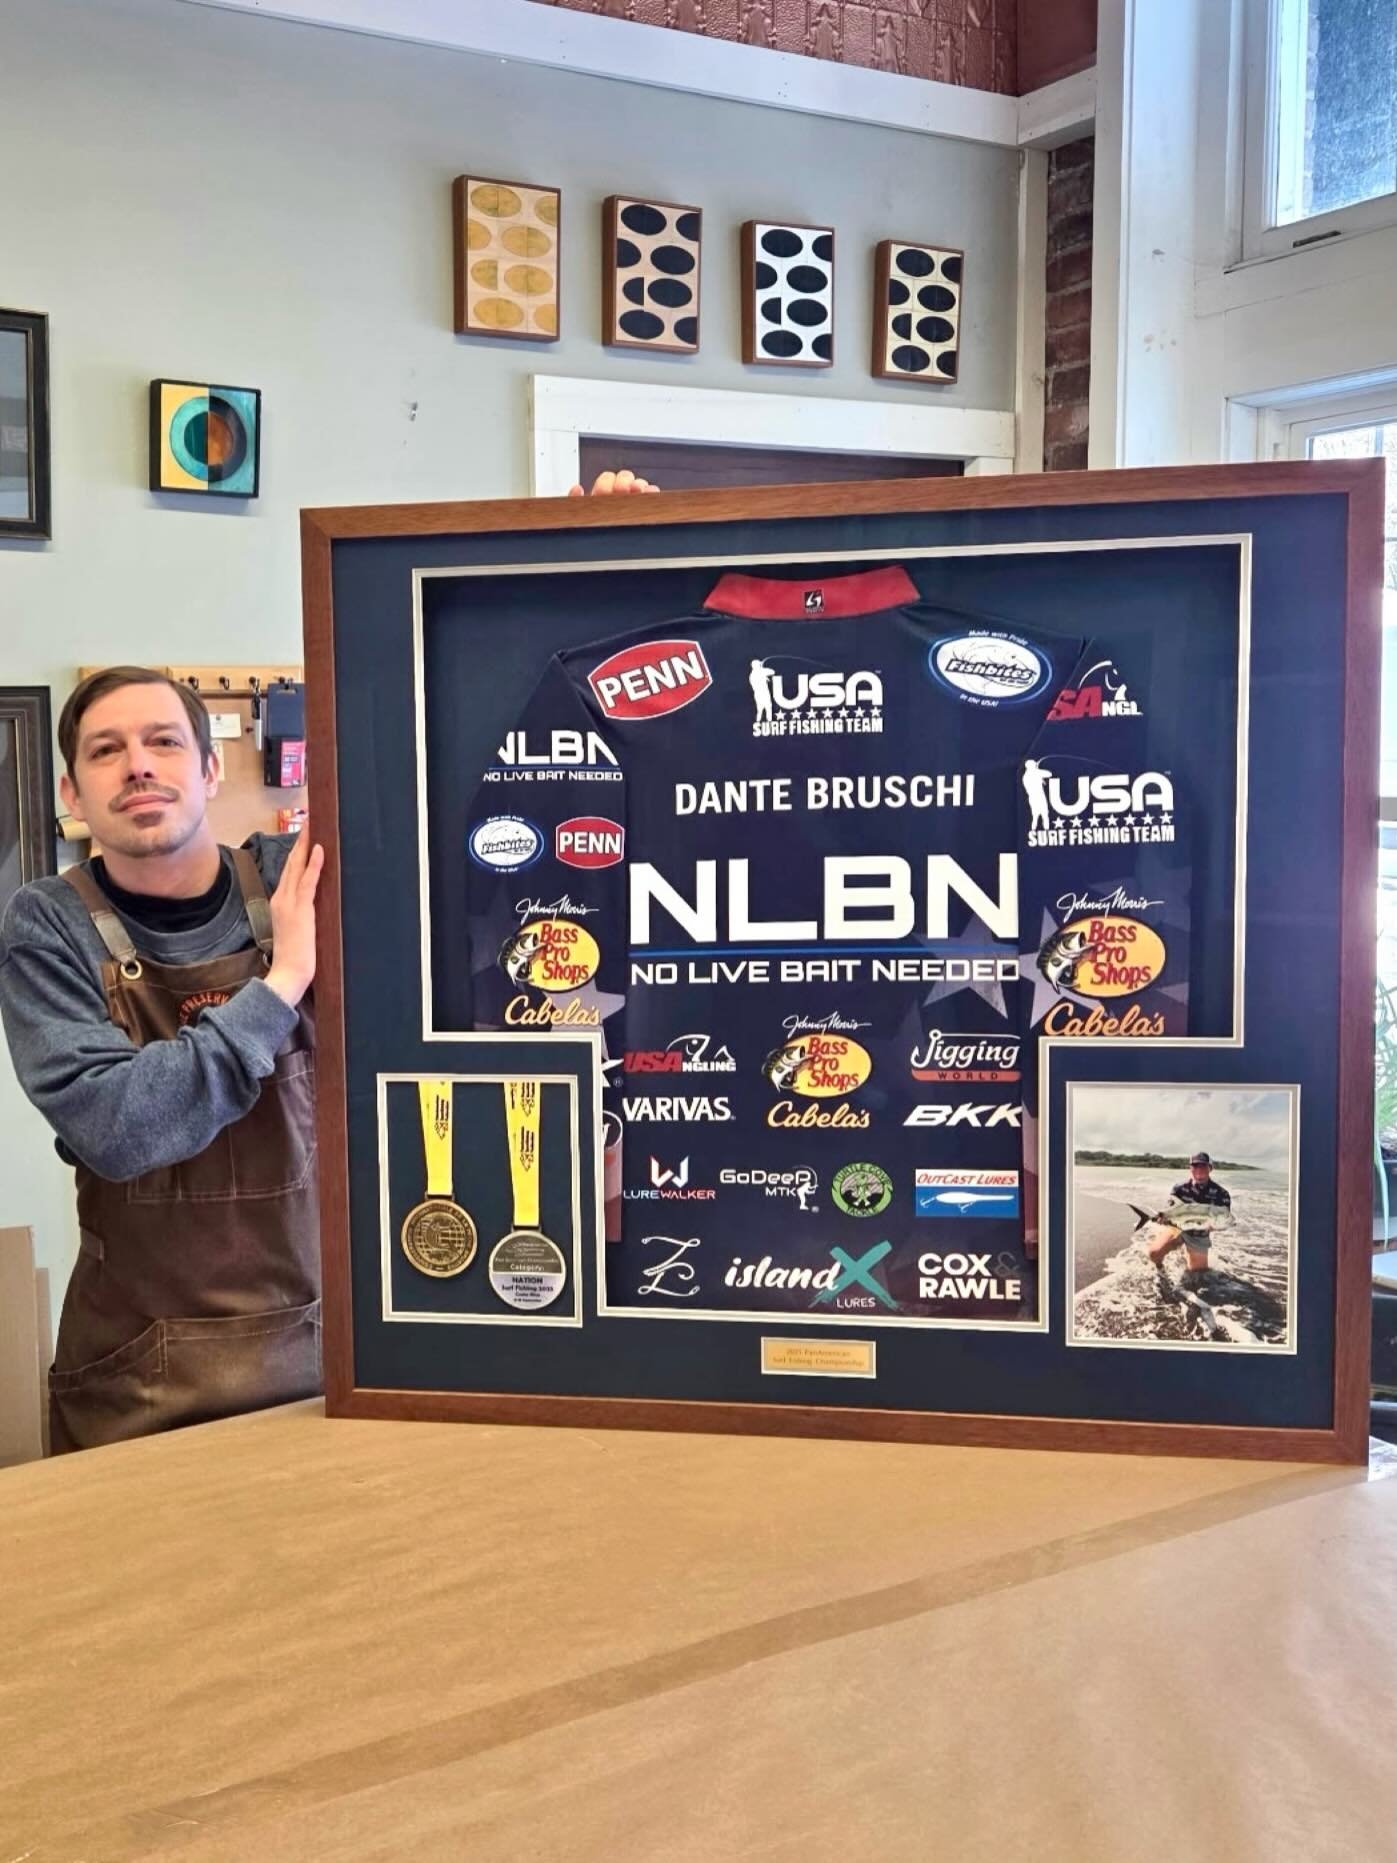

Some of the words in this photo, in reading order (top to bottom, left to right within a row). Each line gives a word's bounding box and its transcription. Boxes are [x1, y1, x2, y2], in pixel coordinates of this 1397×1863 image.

[597, 650, 704, 708] PENN
[945, 659, 1036, 681] Fishbites
[772, 671, 883, 710] USA
[752, 719, 787, 737] SURF
[788, 718, 844, 736] FISHING
[845, 717, 883, 734] TEAM
[483, 772, 501, 782] NO
[503, 771, 534, 782] LIVE
[537, 770, 566, 781] BAIT
[568, 770, 623, 781] NEEDED
[675, 778, 793, 816] DANTE
[807, 774, 975, 810] BRUSCHI
[1049, 771, 1174, 816] USA
[559, 831, 621, 854] PENN
[1028, 828, 1067, 847] SURF
[1069, 826, 1130, 846] FISHING
[1133, 824, 1175, 844] TEAM
[629, 852, 1019, 945] NLBN
[539, 923, 579, 944] Bass
[1087, 920, 1137, 943] Bass
[540, 943, 570, 961] Pro
[1090, 943, 1128, 963] Pro
[542, 960, 589, 984] Shops
[630, 963, 678, 985] NO
[688, 961, 770, 984] LIVE
[780, 959, 863, 983] BAIT
[871, 959, 1020, 982] NEEDED
[1091, 962, 1152, 989] Shops
[504, 995, 601, 1026] Cabela's
[1044, 1002, 1166, 1036] Cabela's
[807, 1037, 849, 1055] Bass
[910, 1029, 1021, 1069] Jigging
[808, 1056, 840, 1072] Pro
[808, 1070, 860, 1092] Shops
[937, 1071, 999, 1081] WORLD
[622, 1096, 732, 1121] VARIVAS
[767, 1100, 871, 1128] Cabela's
[903, 1102, 1023, 1127] BKK
[623, 1189, 716, 1200] LUREWALKER
[765, 1186, 799, 1197] MTK
[918, 1252, 992, 1277] COX
[919, 1277, 1021, 1301] RAWLE
[836, 1297, 876, 1310] LURES
